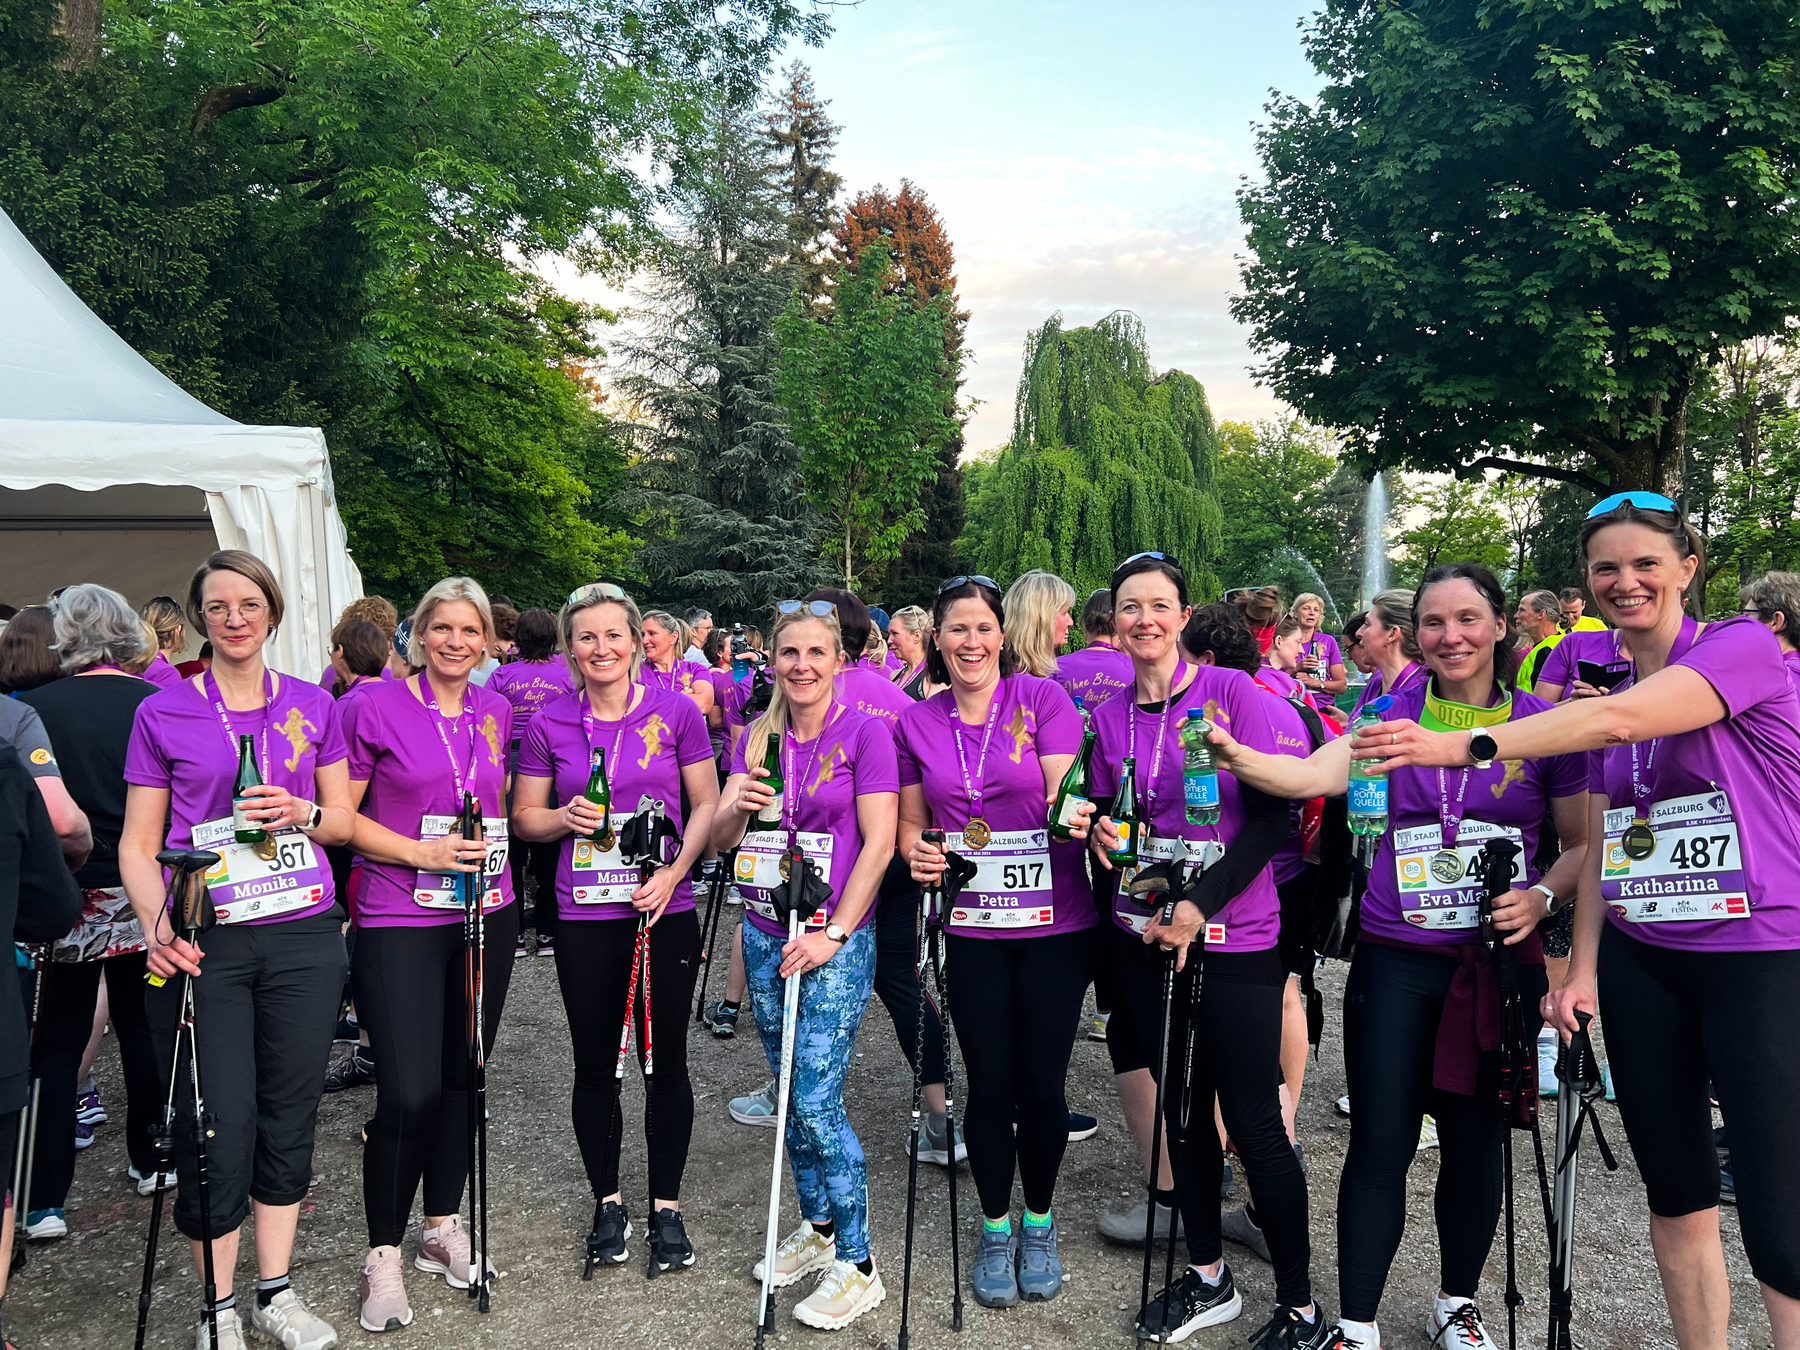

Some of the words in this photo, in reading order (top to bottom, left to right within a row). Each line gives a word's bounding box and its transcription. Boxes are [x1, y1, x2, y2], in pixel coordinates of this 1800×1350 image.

[509, 681, 530, 695] Ohne
[1065, 678, 1090, 695] Ohne
[1093, 672, 1127, 688] Bäuer
[524, 690, 546, 704] läuft
[1084, 689, 1111, 704] läuft
[1438, 704, 1475, 728] OTSO
[1156, 722, 1165, 749] Frauenlauf
[1277, 731, 1305, 748] äuer
[1152, 749, 1161, 777] Salzburger
[1184, 785, 1207, 793] OMER
[1354, 798, 1386, 807] QUELLE
[1656, 803, 1704, 817] SALZBURG
[214, 824, 235, 835] STAD
[1414, 831, 1440, 840] STADT
[1459, 825, 1492, 834] LZBURG
[989, 837, 1028, 845] SALZBURG
[1612, 849, 1625, 857] Bio
[1670, 834, 1731, 869] 487
[483, 849, 506, 872] 67
[597, 870, 638, 884] Maria
[1003, 862, 1044, 889] 517
[233, 876, 297, 899] Monika
[1620, 875, 1719, 896] Katharina
[979, 894, 1019, 907] Petra
[1419, 893, 1452, 907] Eva
[1711, 902, 1724, 911] AK
[1165, 902, 1174, 918] LEKI
